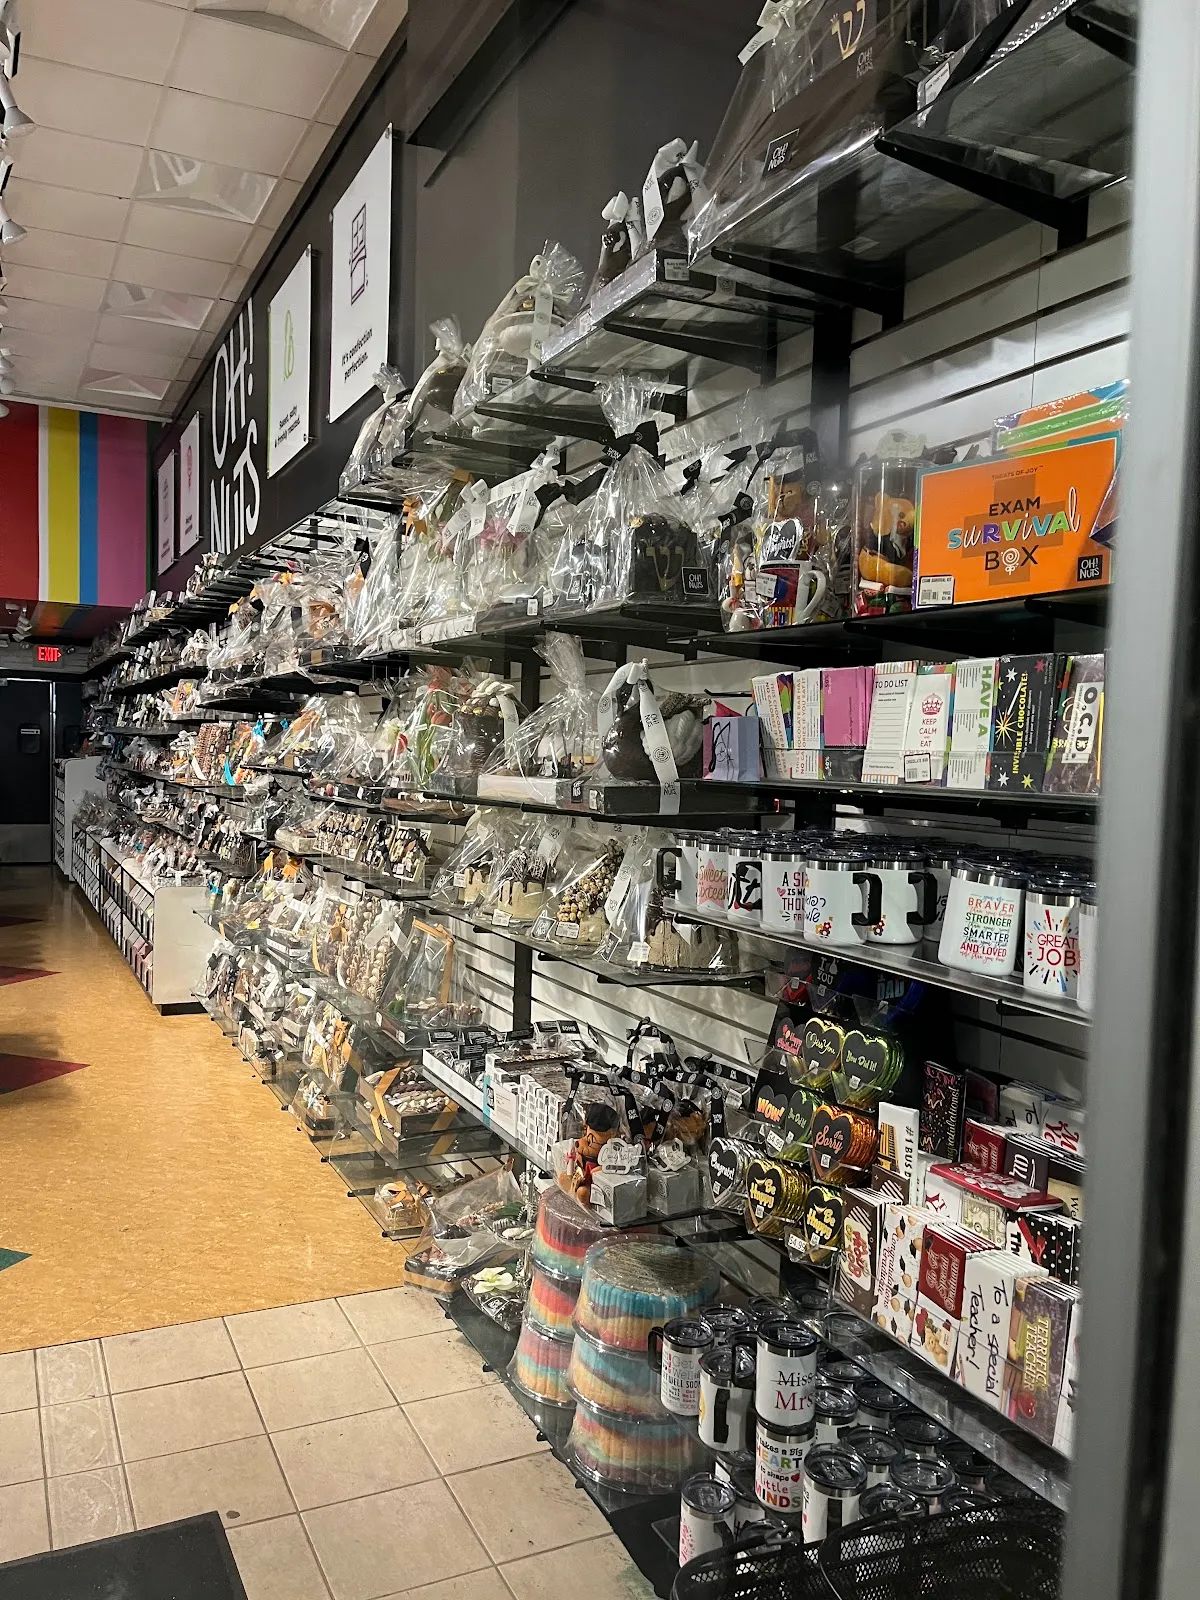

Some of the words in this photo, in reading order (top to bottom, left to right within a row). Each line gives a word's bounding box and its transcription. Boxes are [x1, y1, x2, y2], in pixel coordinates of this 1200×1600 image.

[772, 142, 789, 159] OH!
[767, 154, 785, 172] NUTS
[348, 328, 373, 359] confection
[211, 297, 254, 469] OH!
[992, 472, 1014, 481] TREATS
[210, 418, 261, 556] NUTS
[989, 496, 1041, 516] EXAM
[1081, 558, 1099, 569] OH!
[688, 573, 702, 582] OH!
[1080, 568, 1100, 579] NUTS
[688, 581, 704, 589] NUTS
[38, 646, 58, 662] EXIT
[765, 682, 771, 693] NO
[875, 681, 883, 689] TO
[885, 680, 894, 688] DO
[894, 679, 909, 687] LIST
[979, 665, 993, 719] HAVE
[1017, 672, 1028, 728] CHOCOLATE!
[767, 694, 777, 728] CALORIES
[773, 700, 784, 742] CHOCOLATE
[977, 723, 988, 738] A
[919, 727, 937, 735] CALM
[1012, 730, 1025, 774] INVISIBLE
[800, 763, 805, 775] NO
[698, 865, 727, 882] Sweet
[782, 872, 789, 887] A
[787, 888, 796, 896] IS
[968, 897, 1015, 912] BRAVER
[965, 912, 1012, 927] STRONGER
[963, 927, 1009, 943] SMARTER
[1037, 933, 1078, 949] GREAT
[960, 942, 979, 953] AND
[982, 946, 1007, 957] LOVED
[1037, 946, 1077, 967] JOB
[816, 970, 834, 985] YOU
[877, 979, 905, 1000] DAD
[846, 1050, 857, 1063] You
[858, 1056, 869, 1069] Did
[869, 1060, 877, 1072] It!
[757, 1097, 785, 1122] WOW!
[1025, 1102, 1039, 1125] To
[946, 1085, 960, 1160] ngratulations!
[768, 1132, 784, 1150] $4.99
[814, 1125, 844, 1154] Sorry
[904, 1147, 913, 1169] BUS
[710, 1157, 735, 1181] Congrats!
[749, 1182, 775, 1209] Happy
[765, 1178, 777, 1195] Be
[807, 1207, 832, 1240] Happy
[823, 1208, 836, 1227] Be
[846, 1224, 853, 1242] OF
[788, 1234, 807, 1253] $4.99
[853, 1231, 865, 1268] PROUD
[878, 1248, 889, 1296] Graduate
[883, 1232, 899, 1310] Congratulations
[935, 1253, 950, 1299] Special
[943, 1253, 960, 1311] Graduate!
[994, 1279, 1009, 1306] To
[966, 1284, 984, 1370] Teacher!
[992, 1313, 1000, 1324] a
[672, 1355, 694, 1369] Get
[1023, 1324, 1037, 1391] TEACHER
[1036, 1318, 1049, 1389] TERRIFIC
[672, 1367, 693, 1380] Well
[777, 1371, 815, 1387] Miss
[775, 1389, 814, 1411] Mrs
[756, 1443, 802, 1469] HEART
[759, 1438, 779, 1455] takes
[759, 1473, 789, 1494] little
[767, 1469, 790, 1482] shape
[755, 1481, 801, 1508] MINDS
